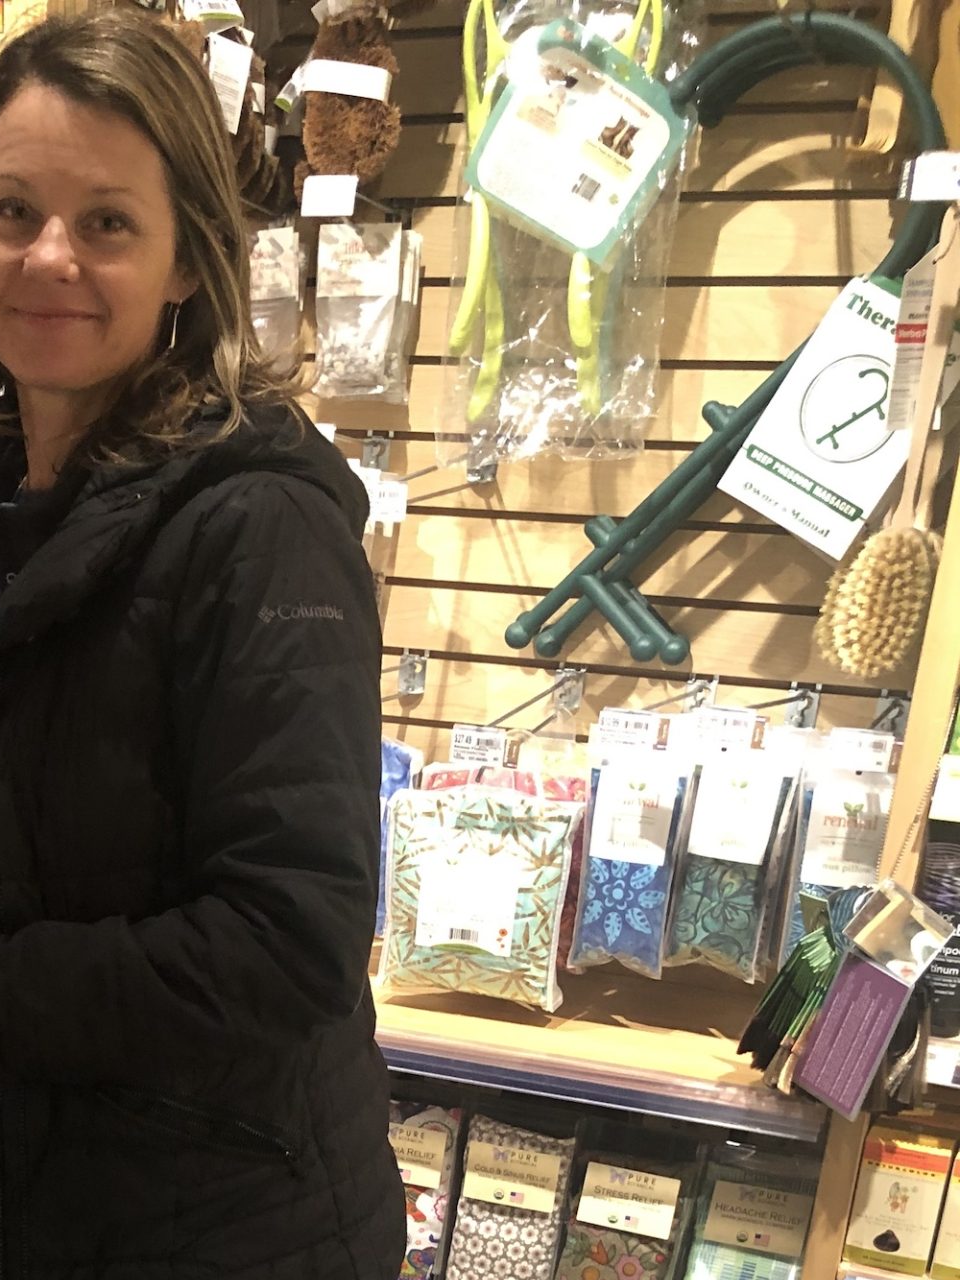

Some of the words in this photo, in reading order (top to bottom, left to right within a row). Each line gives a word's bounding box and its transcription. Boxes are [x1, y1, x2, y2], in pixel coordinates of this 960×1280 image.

[749, 447, 775, 467] DEEP
[810, 484, 858, 518] MASSAGER
[791, 508, 831, 538] Manual
[277, 602, 344, 620] Columbia
[931, 963, 959, 976] tinum
[398, 1128, 426, 1141] PURE
[406, 1147, 437, 1161] RELIEF
[510, 1151, 538, 1163] PURE
[474, 1163, 494, 1174] COLD
[526, 1172, 552, 1184] RELIEF
[628, 1172, 657, 1186] PURE
[593, 1184, 630, 1200] STRESS
[630, 1191, 665, 1207] RELIEF
[758, 1189, 790, 1203] PURE
[714, 1201, 767, 1221] HEADACHE
[769, 1211, 803, 1226] RELIEF
